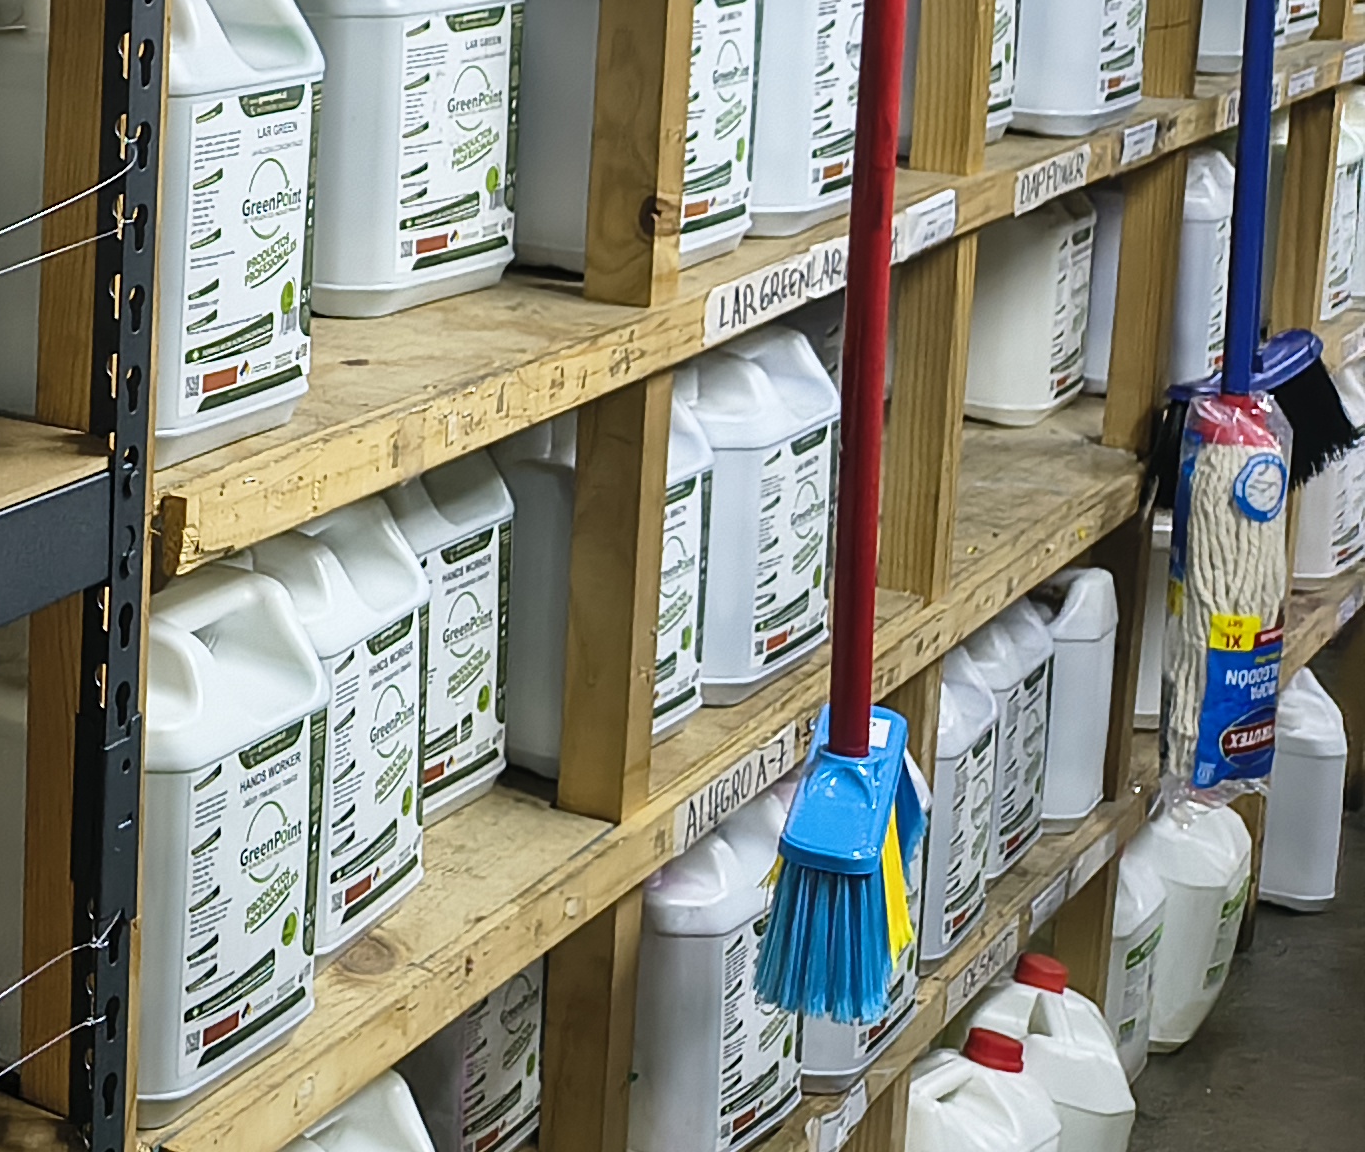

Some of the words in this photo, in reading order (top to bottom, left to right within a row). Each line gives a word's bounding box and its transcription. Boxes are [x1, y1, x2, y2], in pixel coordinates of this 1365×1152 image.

[447, 89, 503, 113] GreenPoint
[241, 188, 302, 217] GreenPoint
[719, 282, 758, 329] LAR
[760, 260, 811, 311] GREEN
[442, 608, 493, 644] GreenPoint
[1221, 633, 1242, 649] XL
[239, 769, 267, 794] HANDS
[268, 751, 302, 778] WORKER
[240, 820, 302, 868] GreenPoint
